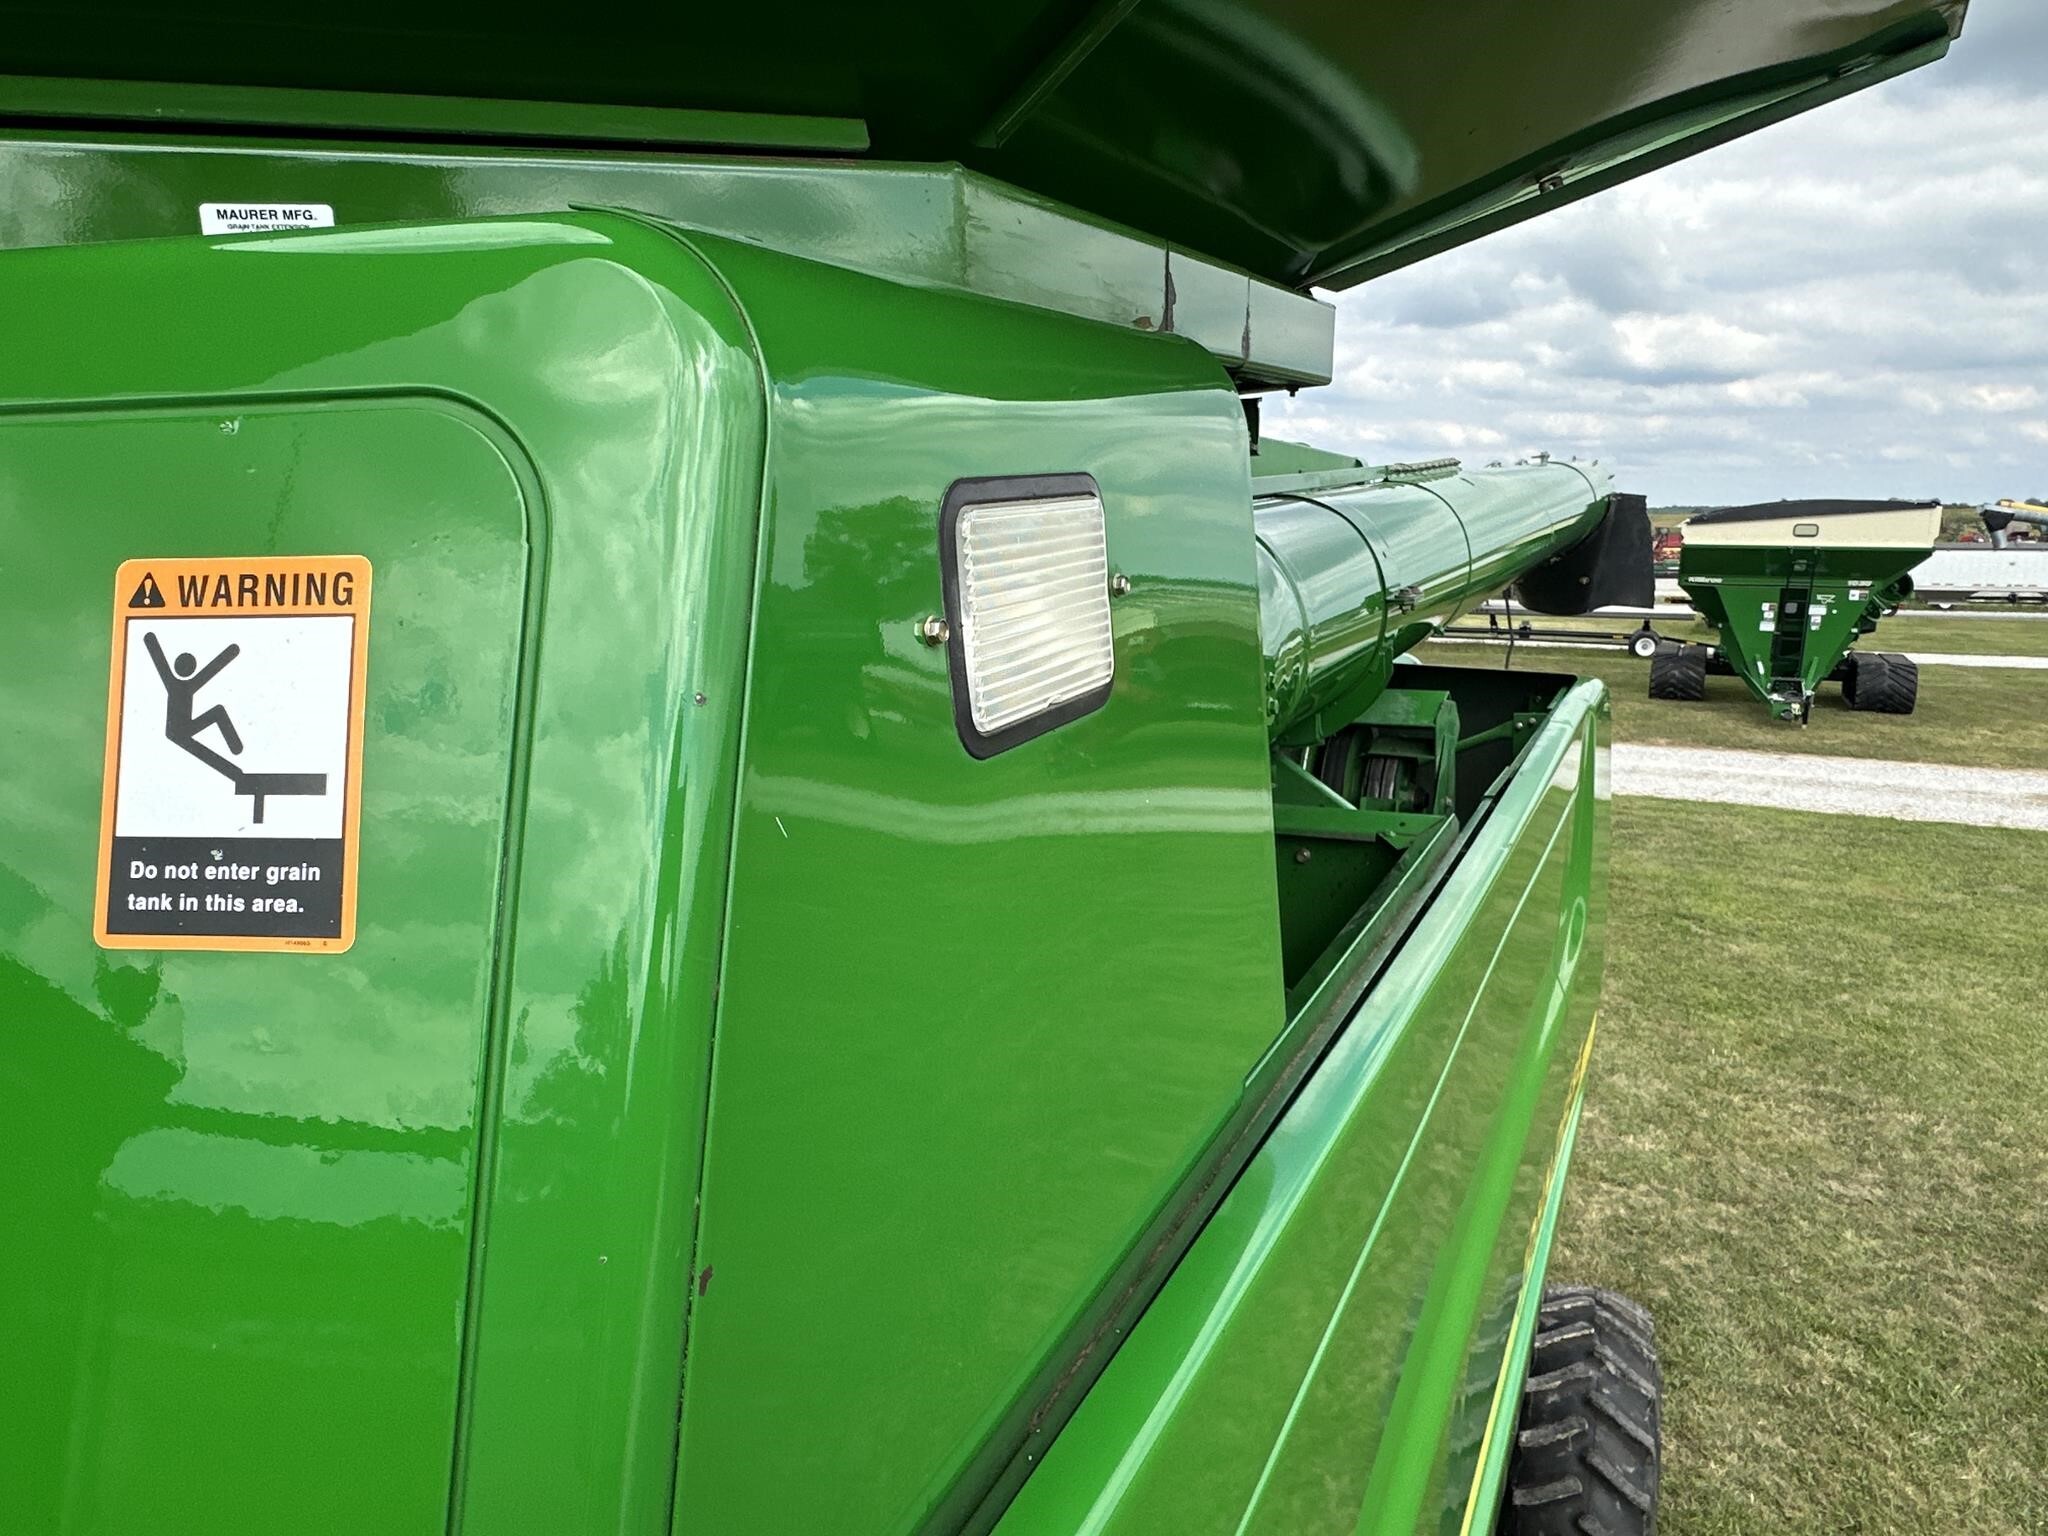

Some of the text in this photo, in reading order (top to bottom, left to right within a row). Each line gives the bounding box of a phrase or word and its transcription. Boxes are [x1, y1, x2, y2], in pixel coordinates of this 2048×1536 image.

[216, 208, 318, 221] MAURER MFG.
[177, 571, 354, 607] WARNING
[129, 860, 321, 885] Do not enter grain
[127, 893, 305, 913] tank in this area.
